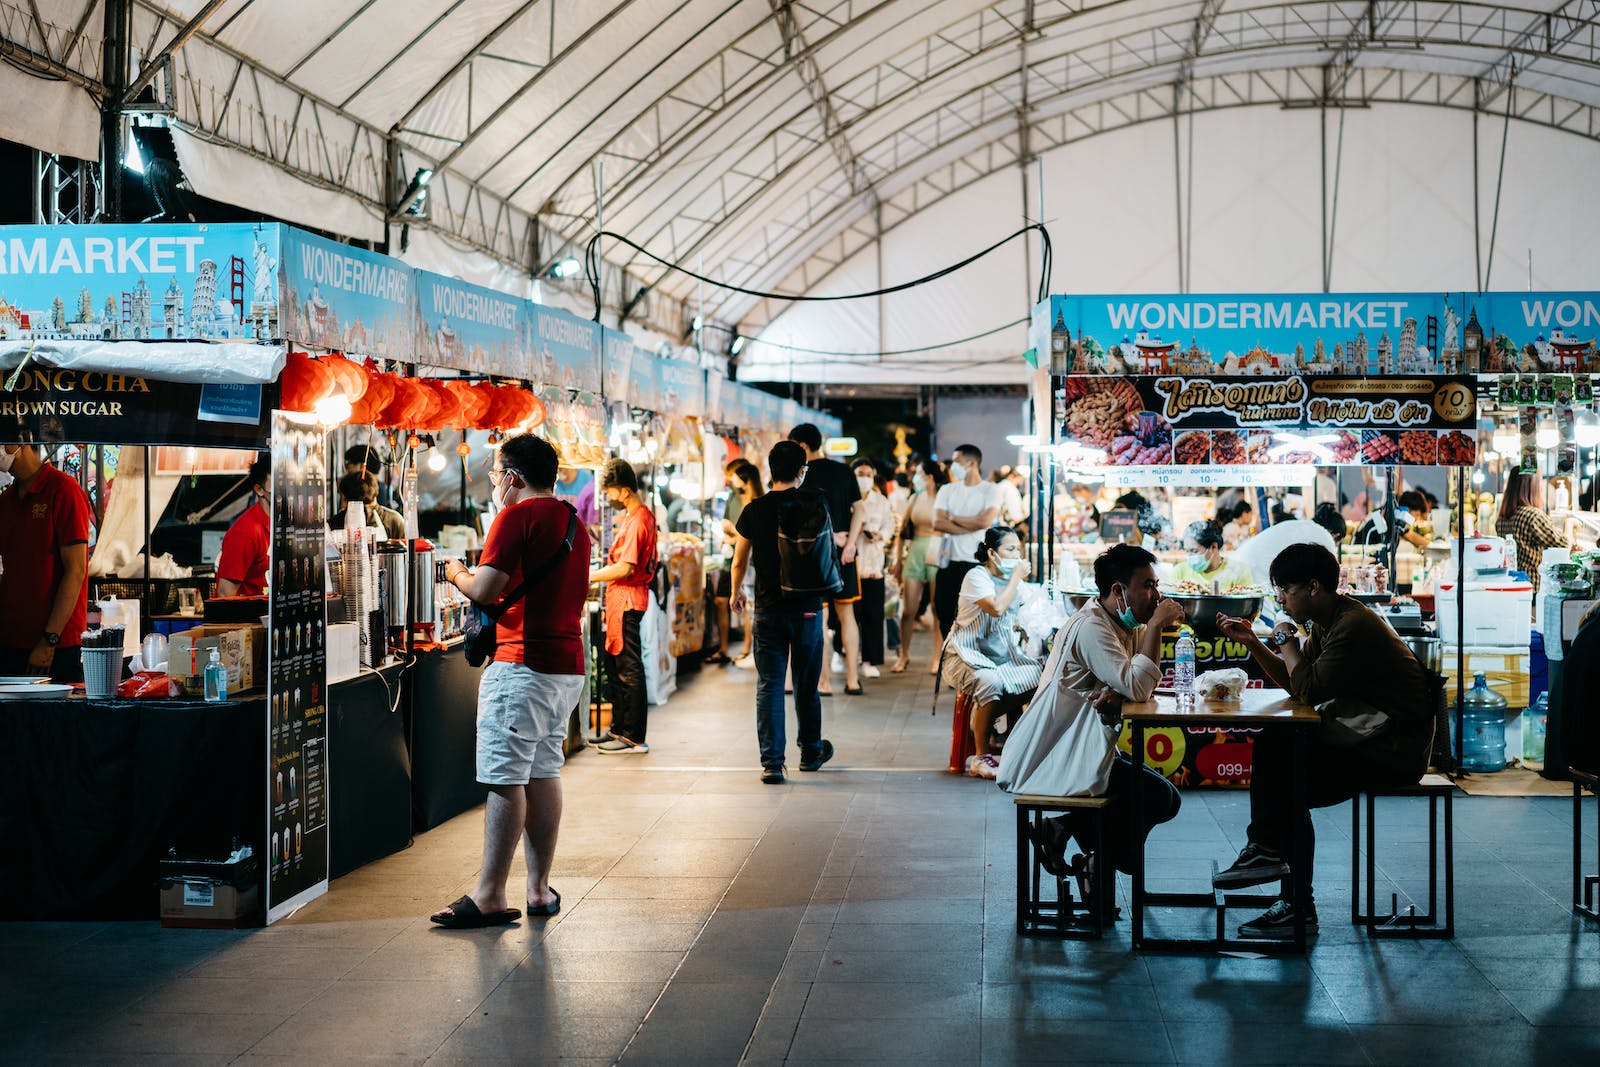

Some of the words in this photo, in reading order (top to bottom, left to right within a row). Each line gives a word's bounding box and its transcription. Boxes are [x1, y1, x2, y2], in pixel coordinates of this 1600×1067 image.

[301, 243, 408, 304] WONDERMARKET
[432, 283, 517, 330] WONDERMARKET
[1107, 302, 1409, 329] WONDERMARKET
[1521, 300, 1600, 327] WON
[538, 311, 593, 350] WONDERMARKET
[83, 371, 150, 392] CHA
[0, 401, 56, 416] ROWN
[59, 401, 123, 417] SUGAR
